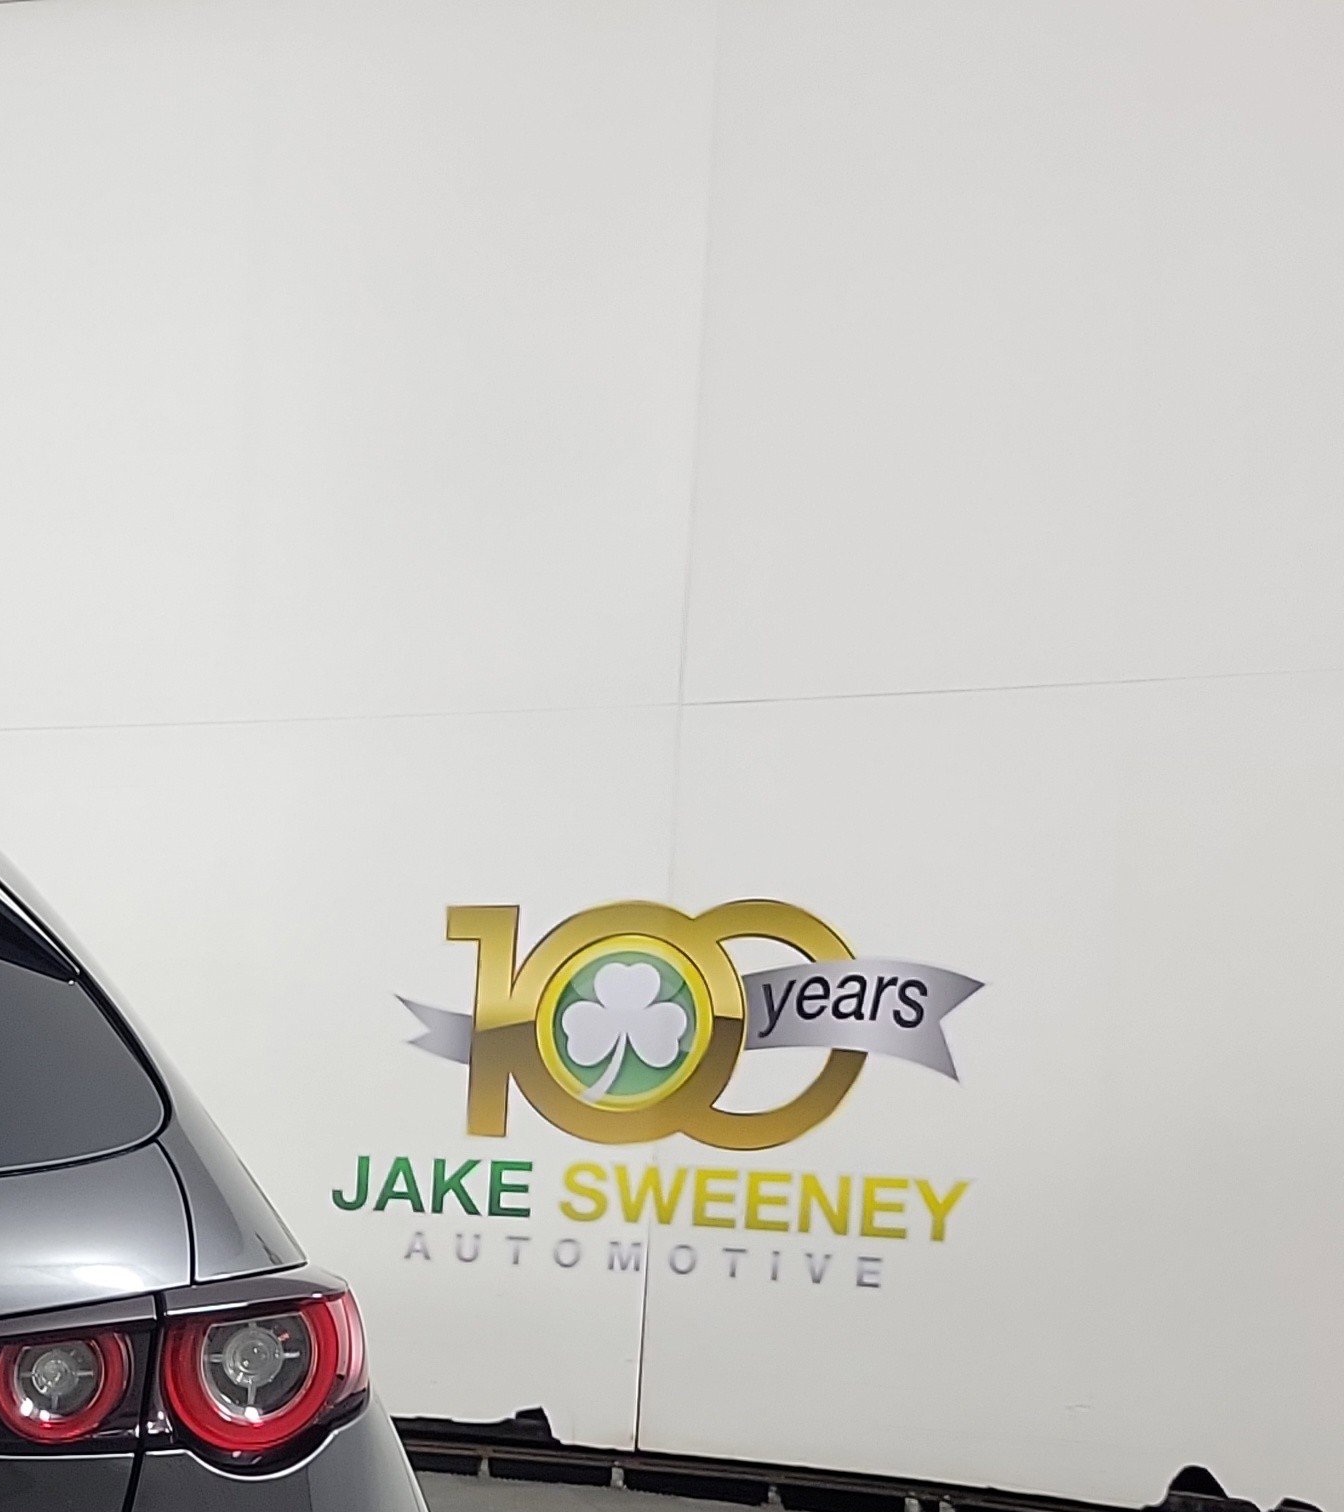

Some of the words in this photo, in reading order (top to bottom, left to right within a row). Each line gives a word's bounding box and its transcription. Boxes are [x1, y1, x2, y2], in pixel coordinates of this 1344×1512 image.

[446, 898, 868, 1150] 100
[758, 970, 928, 1038] years
[331, 1155, 533, 1218] JAKE
[559, 1163, 969, 1243] SWEENEY
[403, 1231, 884, 1289] AUTOMOTIVE
